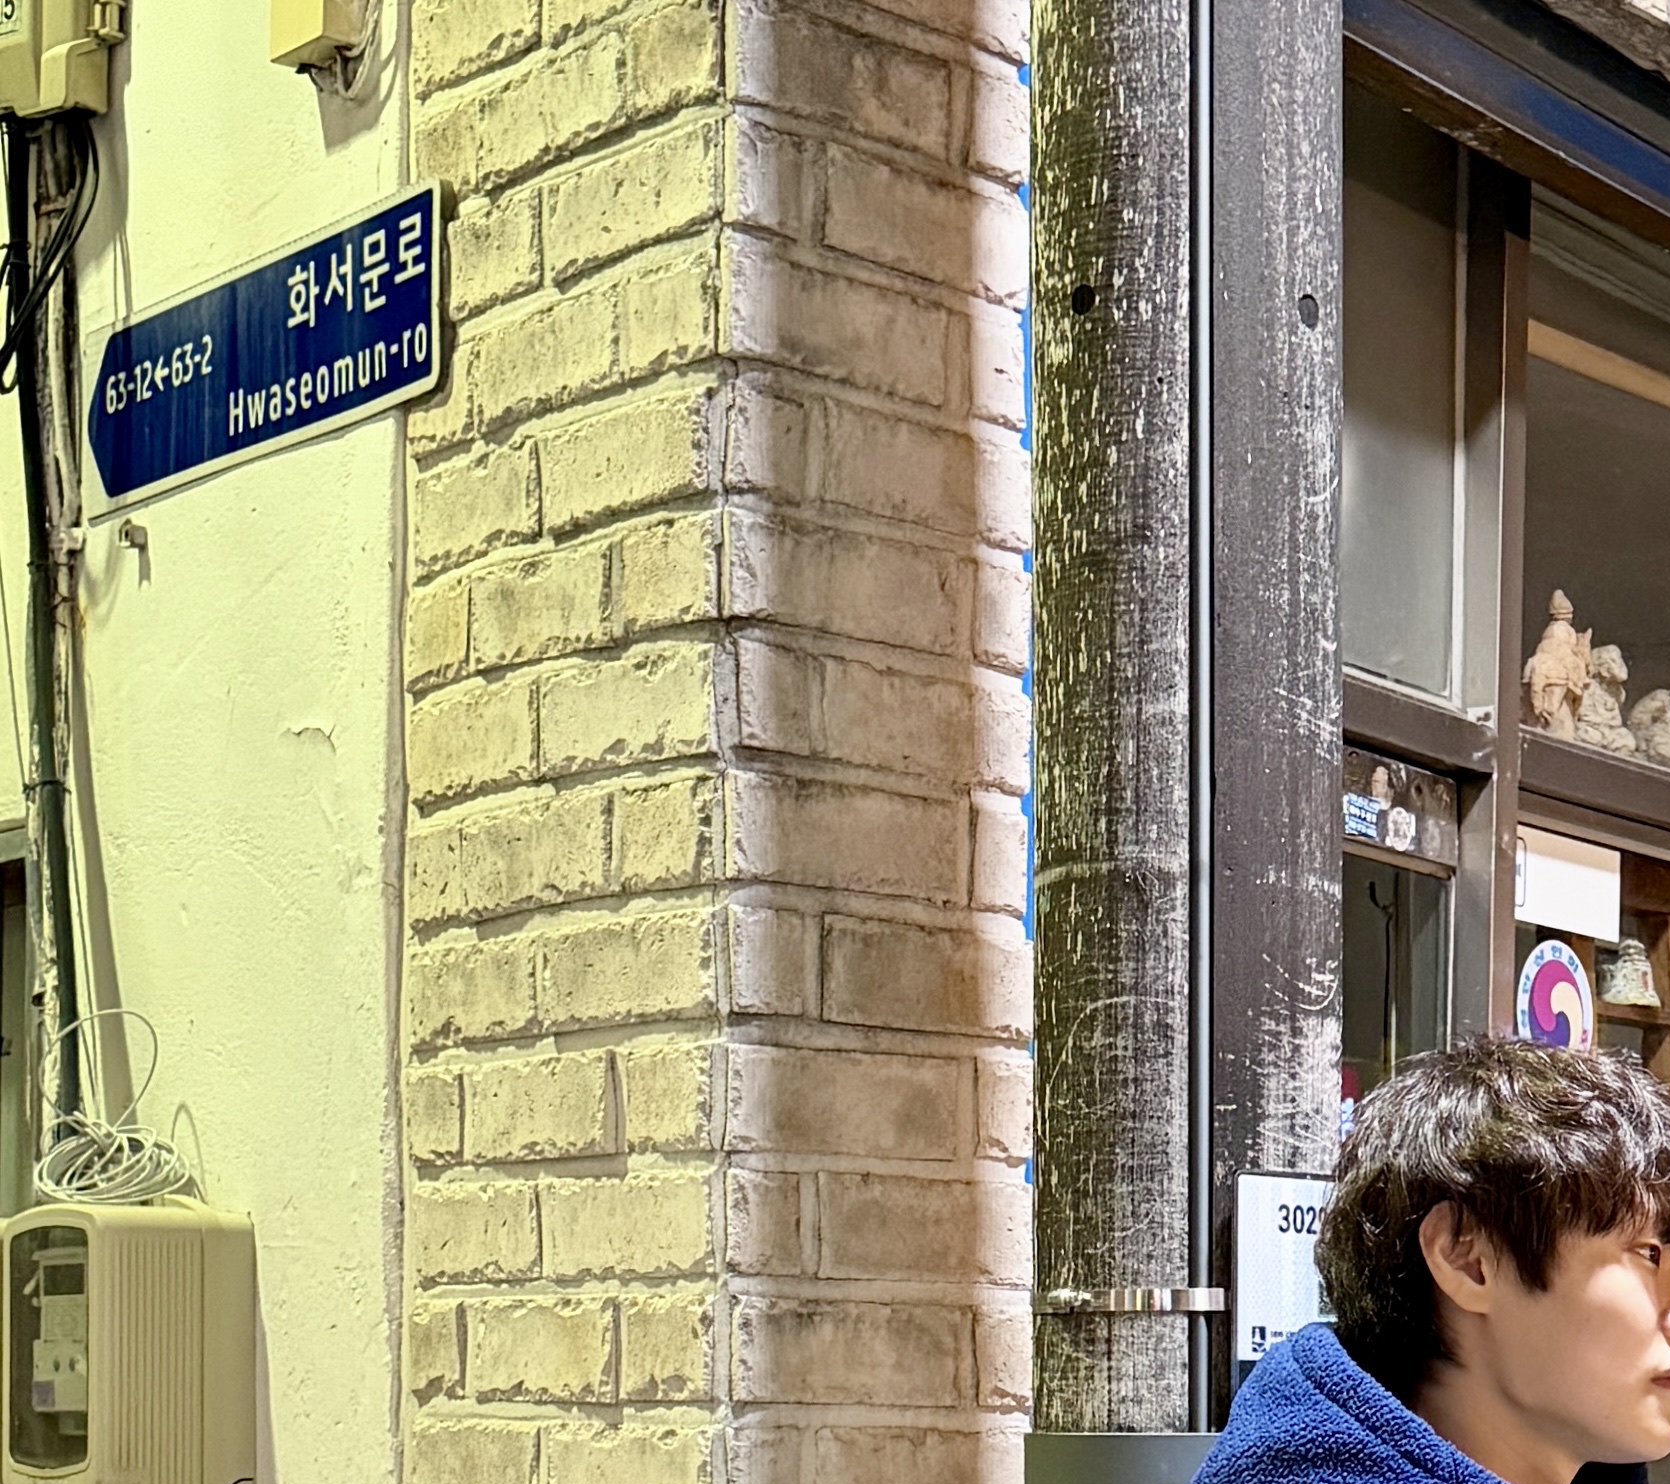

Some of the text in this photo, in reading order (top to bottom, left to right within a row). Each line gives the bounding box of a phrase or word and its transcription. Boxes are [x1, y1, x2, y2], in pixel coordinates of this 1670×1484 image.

[286, 211, 426, 329] 화서문로
[105, 334, 213, 415] 63-12 63-2
[228, 322, 428, 437] Hwaseomun-ro
